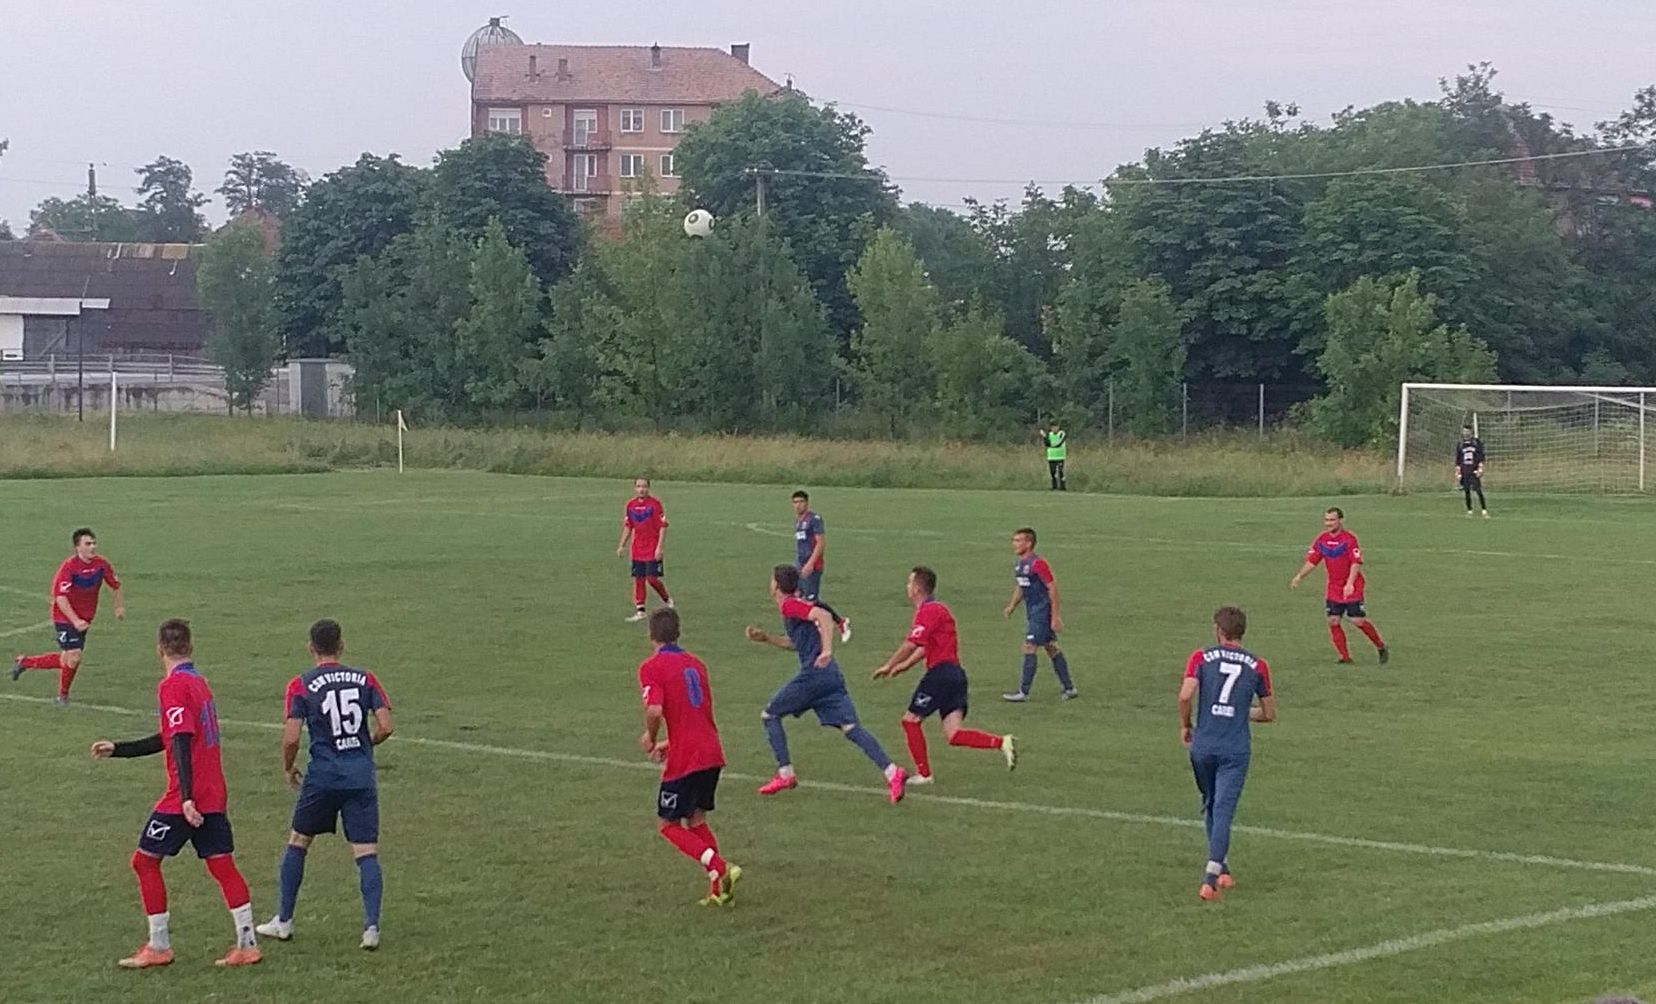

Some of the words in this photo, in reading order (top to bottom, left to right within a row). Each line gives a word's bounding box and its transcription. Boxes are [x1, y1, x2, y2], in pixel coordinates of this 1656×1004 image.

[324, 672, 367, 686] VICTORIA
[1219, 661, 1242, 703] 7
[321, 688, 363, 736] 15
